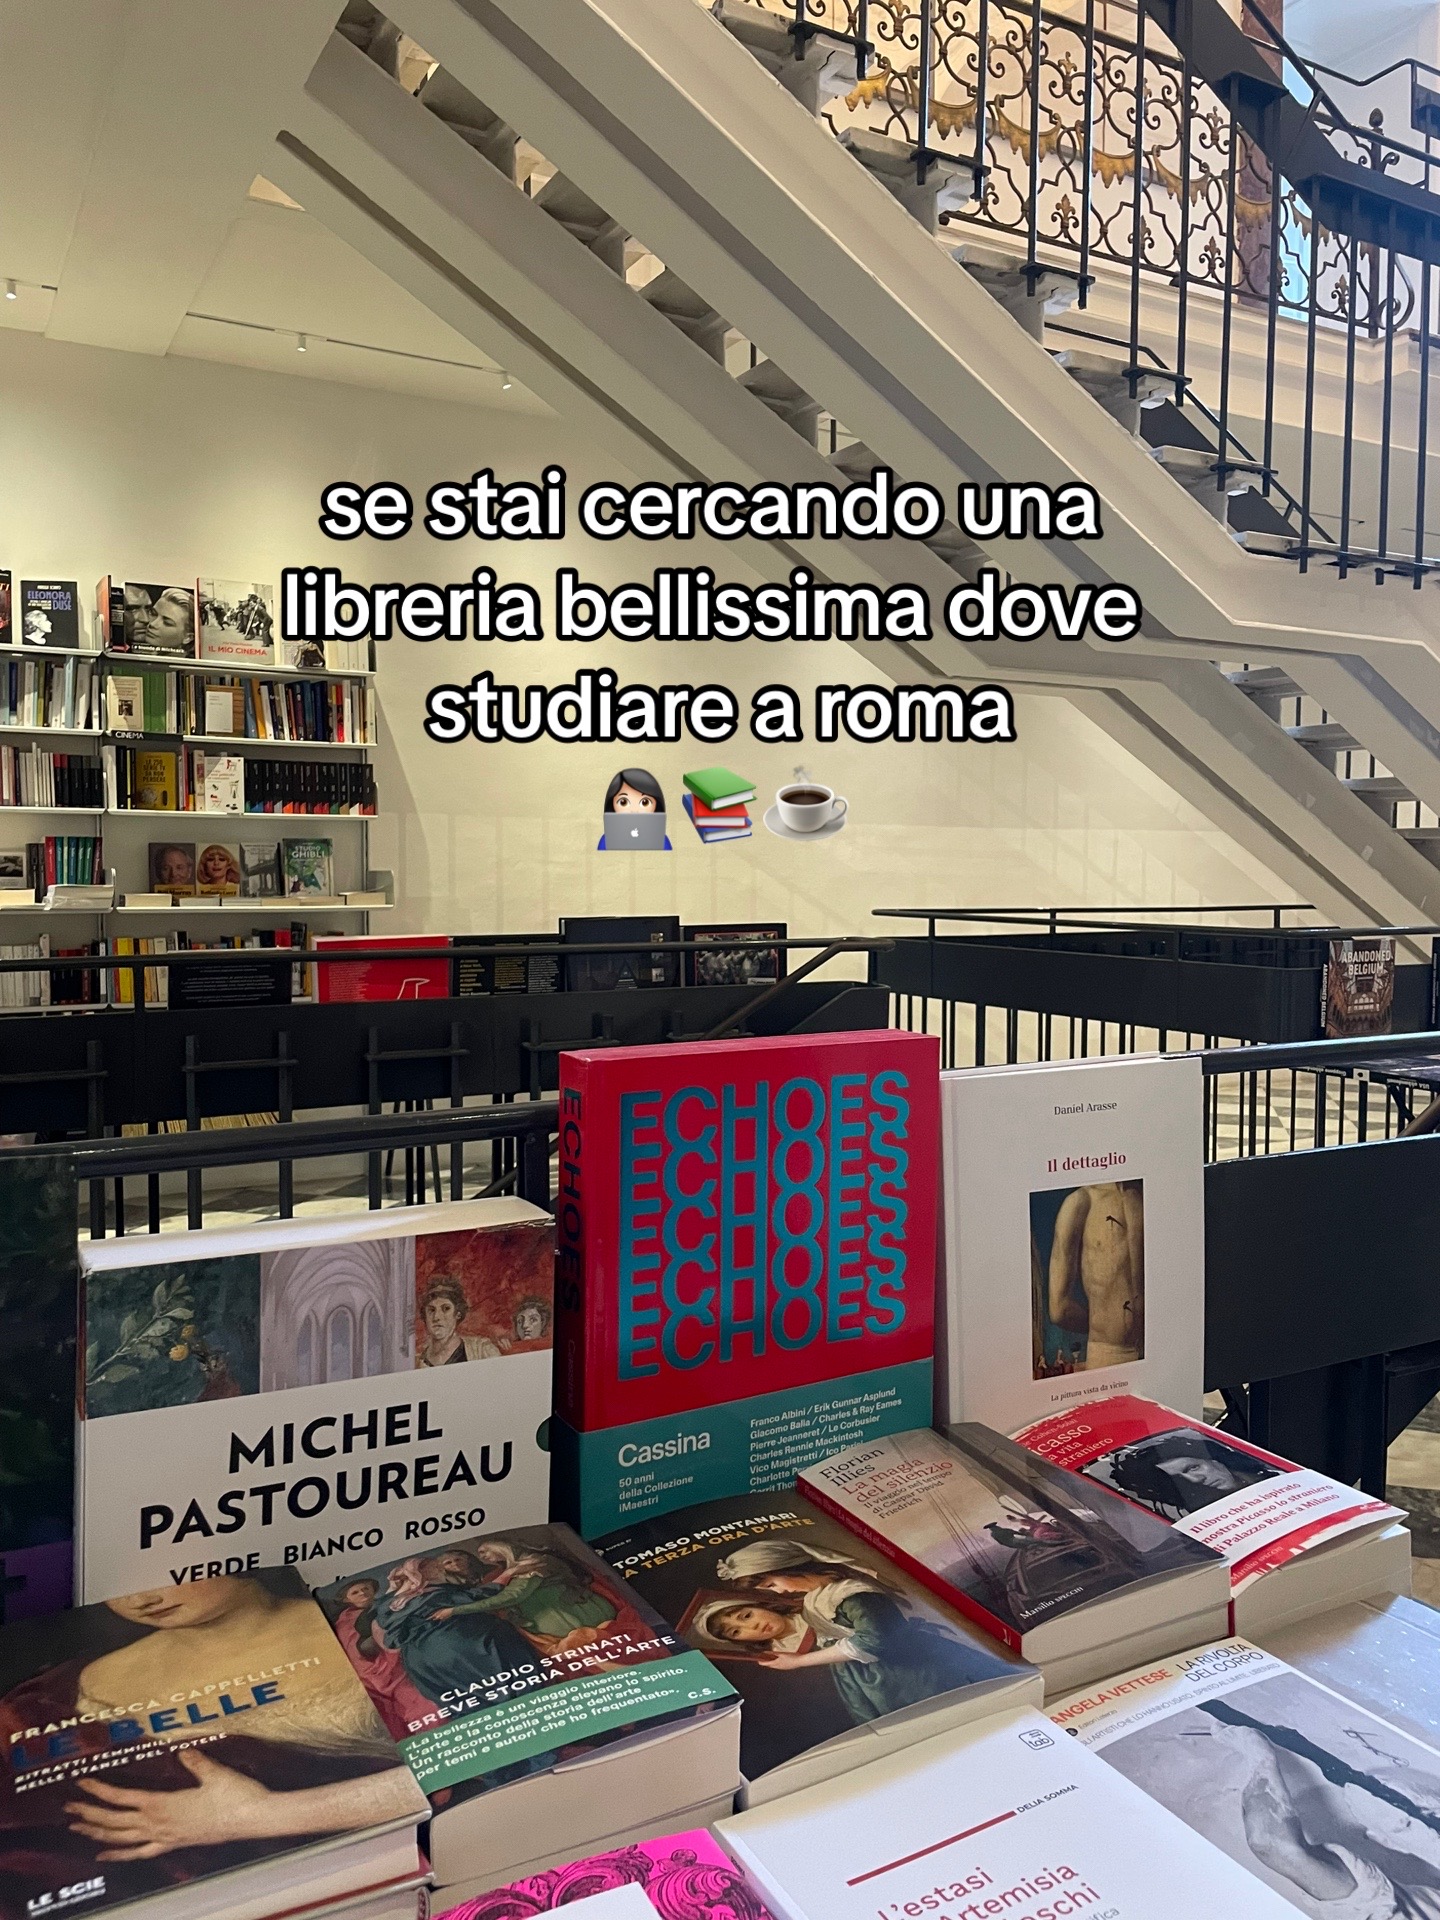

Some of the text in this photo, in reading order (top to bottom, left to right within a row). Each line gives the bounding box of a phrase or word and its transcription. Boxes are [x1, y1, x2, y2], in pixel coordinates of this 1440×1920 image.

[218, 646, 234, 654] MIO
[236, 647, 268, 656] CINEMA
[115, 732, 144, 740] CINEMA
[1341, 950, 1392, 964] ABANDONED
[1348, 962, 1384, 975] BELGIUM
[620, 1071, 909, 1157] ECHOES
[1054, 1100, 1118, 1116] Daniel Arasse
[1048, 1152, 1127, 1173] Il dettaglio
[561, 1088, 582, 1313] ECHOES
[750, 1387, 896, 1428] Franco Albini Erik Gunnar Asplund
[1060, 1380, 1128, 1402] pittura vista vicino
[228, 1400, 444, 1474] MICHEL
[750, 1398, 902, 1440] Giacomo Charles Ray Eames
[750, 1415, 880, 1452] Pierre Jeanneret Le Corbusier
[618, 1432, 710, 1468] Cassina
[750, 1430, 864, 1462] Charles Rennie Mackintosh
[750, 1464, 769, 1474] Vico
[770, 1452, 818, 1470] Magistretti
[1056, 1441, 1083, 1460] vita
[1058, 1438, 1114, 1466] straniero
[620, 1472, 654, 1488] 50 anni
[750, 1471, 790, 1486] Charlotte
[819, 1449, 885, 1480] Florian
[830, 1464, 876, 1487] Illies
[842, 1458, 926, 1496] La magia
[856, 1460, 953, 1504] del silenzio
[140, 1441, 512, 1550] PASTOUREAU
[620, 1476, 694, 1500] della Collezione
[874, 1471, 952, 1506] viaggio tempo
[884, 1480, 944, 1510] Caspar David
[1200, 1482, 1301, 1530] libro che ha ispirato
[1237, 1506, 1276, 1525] Picasso
[1288, 1484, 1334, 1504] straniero
[878, 1496, 922, 1519] Friedrich
[1222, 1523, 1267, 1547] Palazzo
[1264, 1510, 1297, 1526] Reale
[1304, 1493, 1340, 1511] Milano
[170, 1508, 486, 1586] VERDE BIANCO ROSSO
[612, 1512, 798, 1569] TOMASO MONTANARI
[622, 1518, 815, 1580] A TERZA ORA D'ARTE
[1020, 1599, 1055, 1620] Marsilio
[440, 1634, 632, 1702] CLAUDIO STRINATI
[1176, 1644, 1252, 1672] LA RIVOLTA
[1185, 1652, 1264, 1682] DEL CORPO
[10, 1656, 321, 1744] FRANCESCA CAPPELLETTI
[407, 1636, 676, 1732] BREVE STORIA DELL'ARTE
[687, 1687, 716, 1700] C.S.
[1050, 1668, 1173, 1724] ANGELA VETTESE
[408, 1667, 688, 1762] L'arte e la conoscenza elevano lo spirito.
[433, 1670, 642, 1740] bellezza un viaggio interiore.
[12, 1680, 286, 1770] LE BELLE
[412, 1687, 642, 1770] Un racconto della storia dell'arte
[1092, 1725, 1118, 1742] ARTISTI
[14, 1738, 172, 1784] RITRATTI FEMMINILI
[16, 1732, 228, 1794] NELLE STANZE DEL POTERE
[416, 1712, 588, 1781] per temi e autori che ho
[1016, 1784, 1079, 1814] DELIA SOMMA
[27, 1892, 54, 1910] LE
[58, 1876, 106, 1899] SCIE
